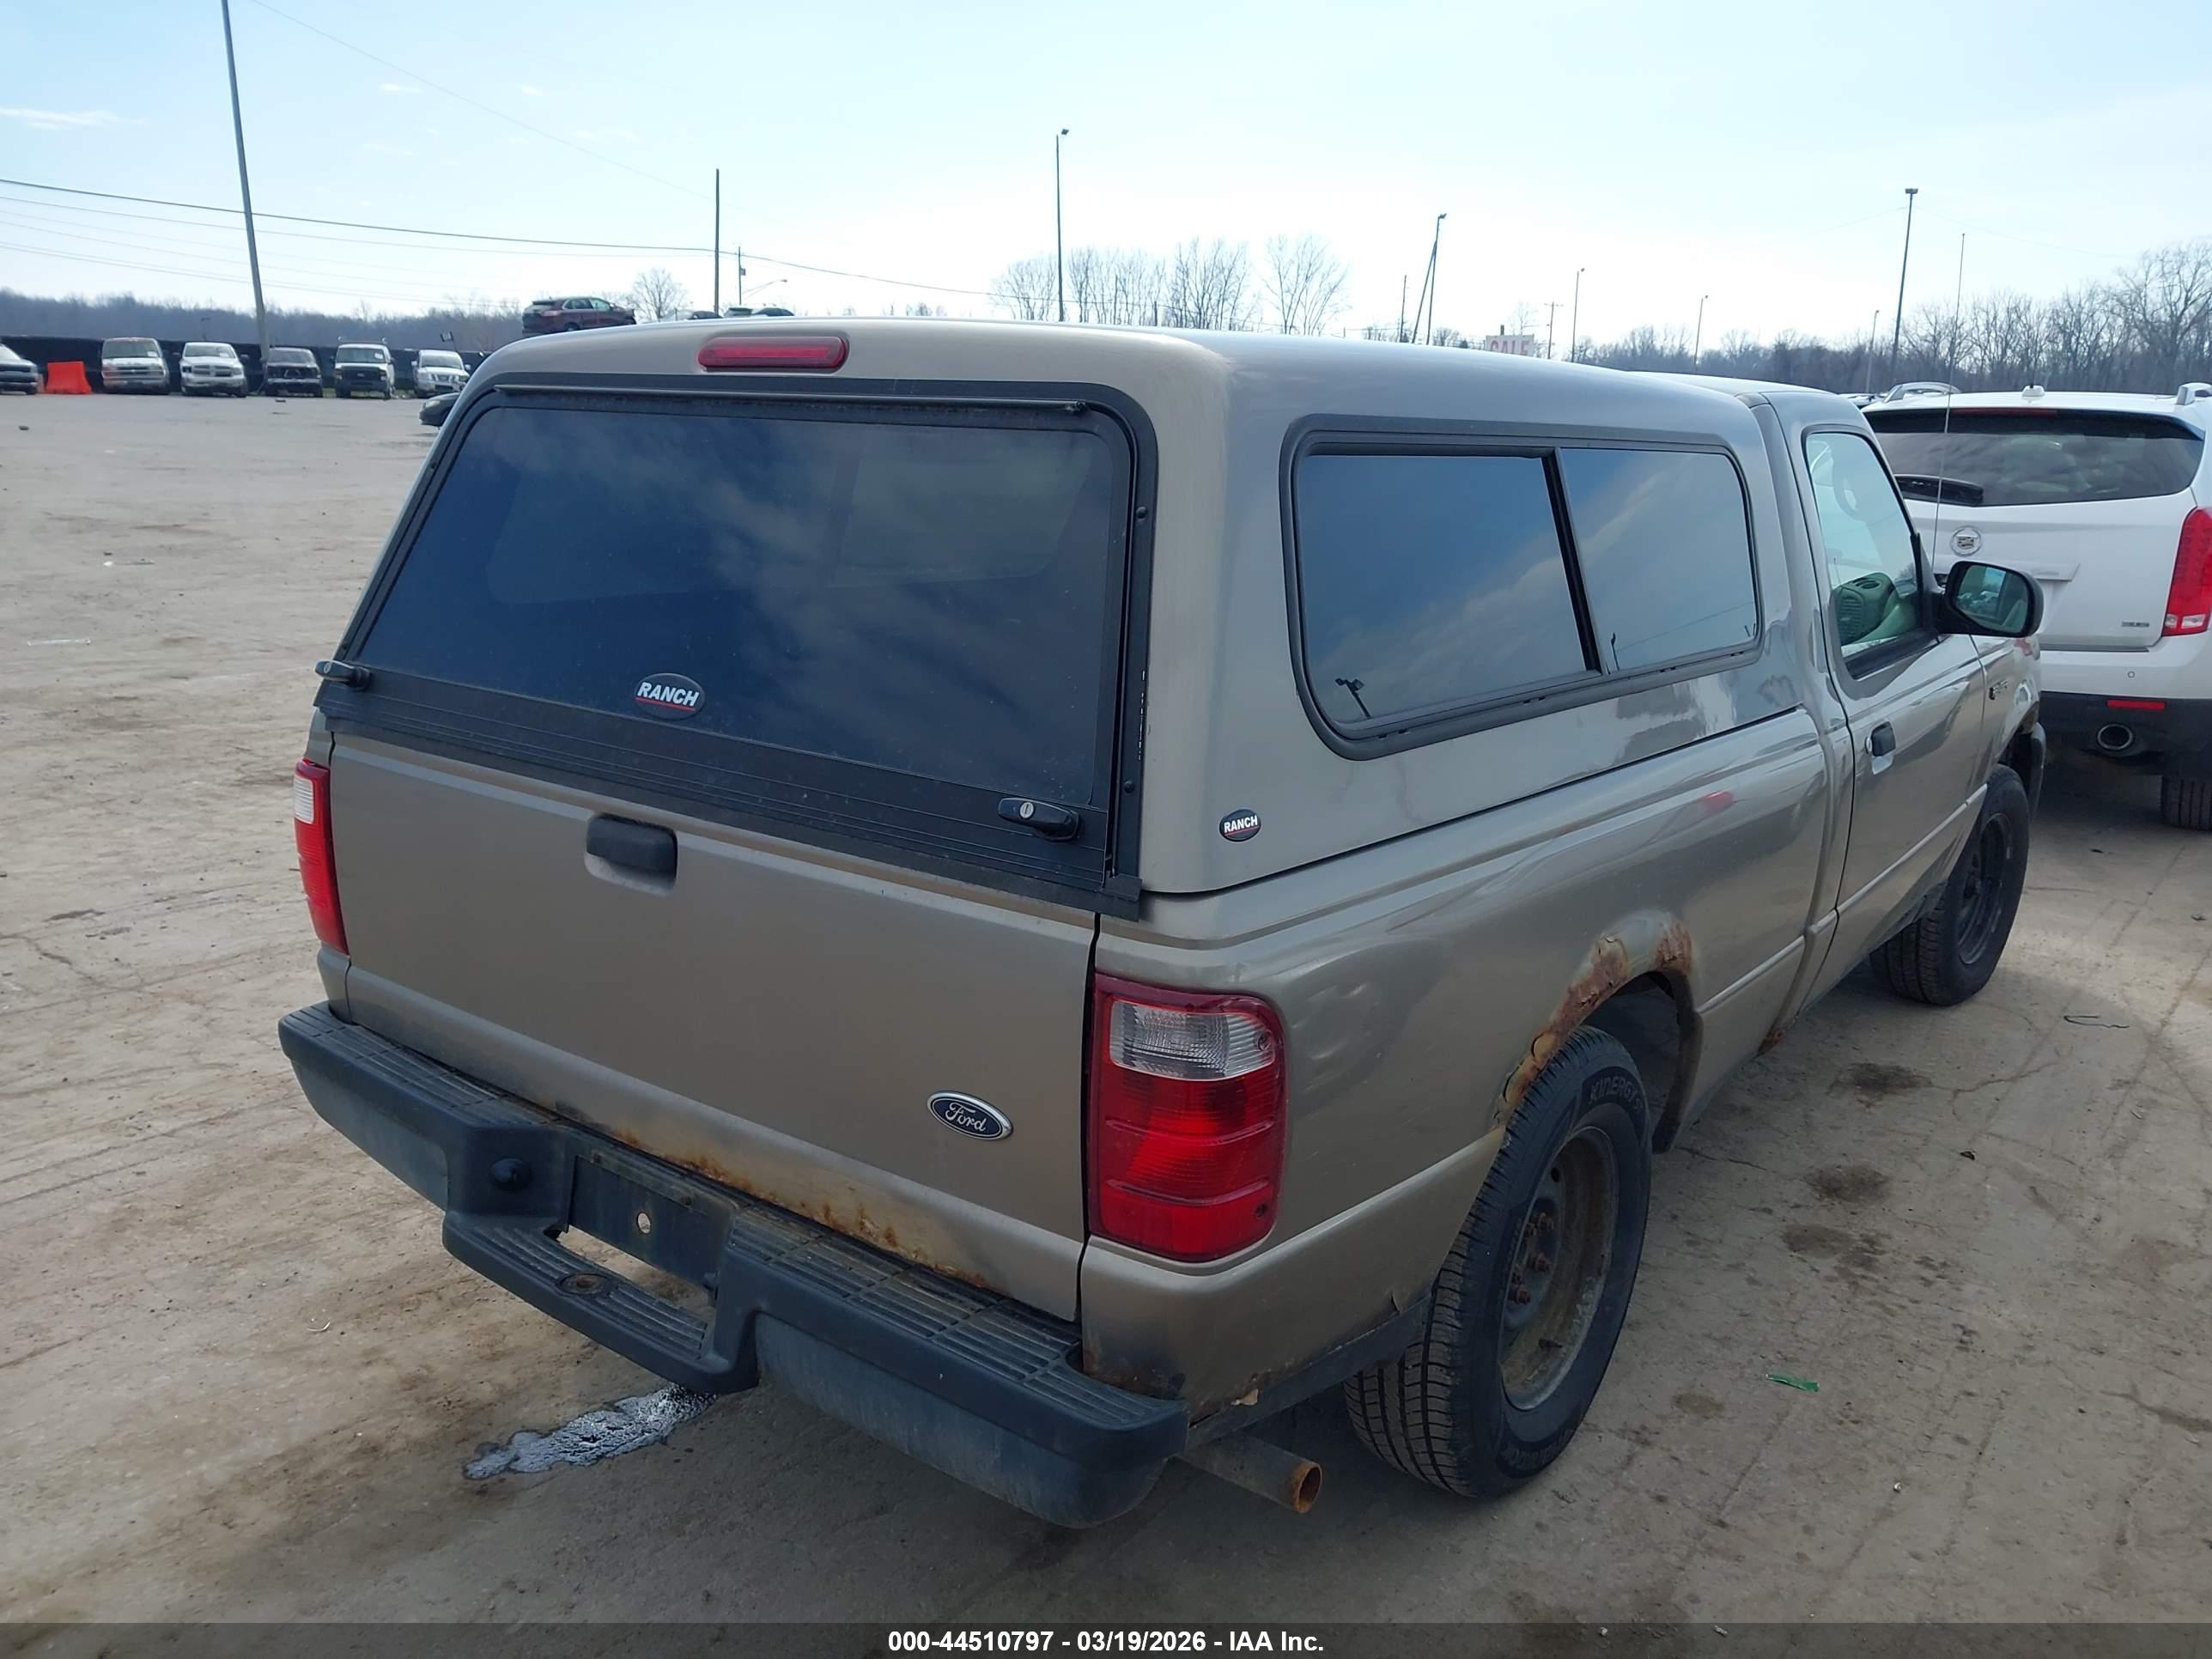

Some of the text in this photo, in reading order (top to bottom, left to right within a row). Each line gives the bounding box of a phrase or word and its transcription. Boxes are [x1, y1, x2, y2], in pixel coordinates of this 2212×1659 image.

[637, 681, 700, 707] RANCH
[1224, 814, 1258, 834] RANCH
[945, 1102, 987, 1132] Ford
